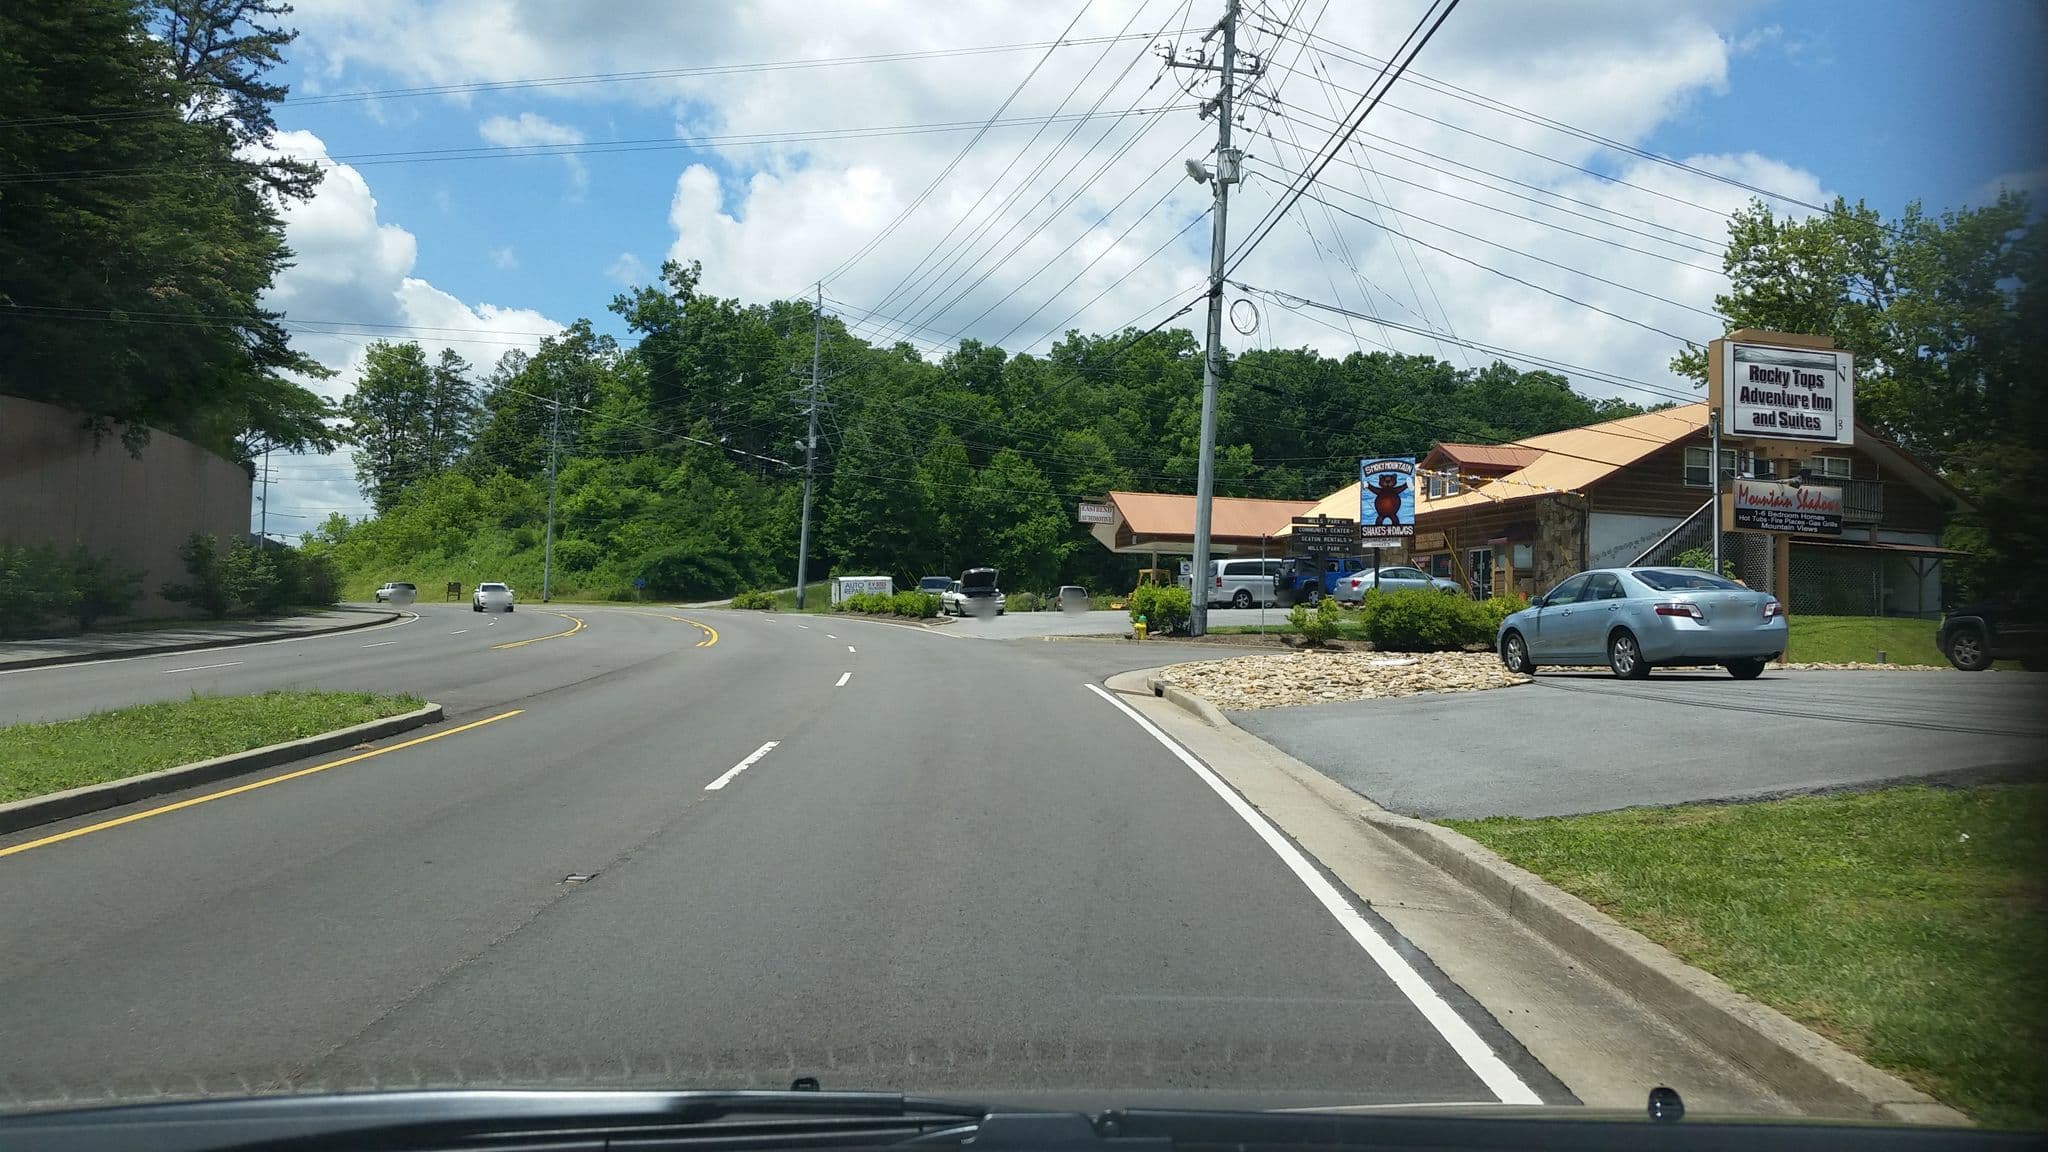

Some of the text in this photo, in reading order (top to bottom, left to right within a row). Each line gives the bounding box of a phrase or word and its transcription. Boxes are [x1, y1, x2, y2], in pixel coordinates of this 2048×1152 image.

[1749, 365, 1825, 391] Rocky Tops
[1740, 386, 1833, 411] Adventure Inn
[1752, 411, 1777, 428] and
[1778, 411, 1822, 431] Suites
[1385, 461, 1413, 473] MOUNTAIN
[1738, 483, 1793, 508] Mountain
[1768, 511, 1799, 519] Bedroom
[1801, 513, 1825, 521] Homes
[1761, 523, 1795, 531] Mountain
